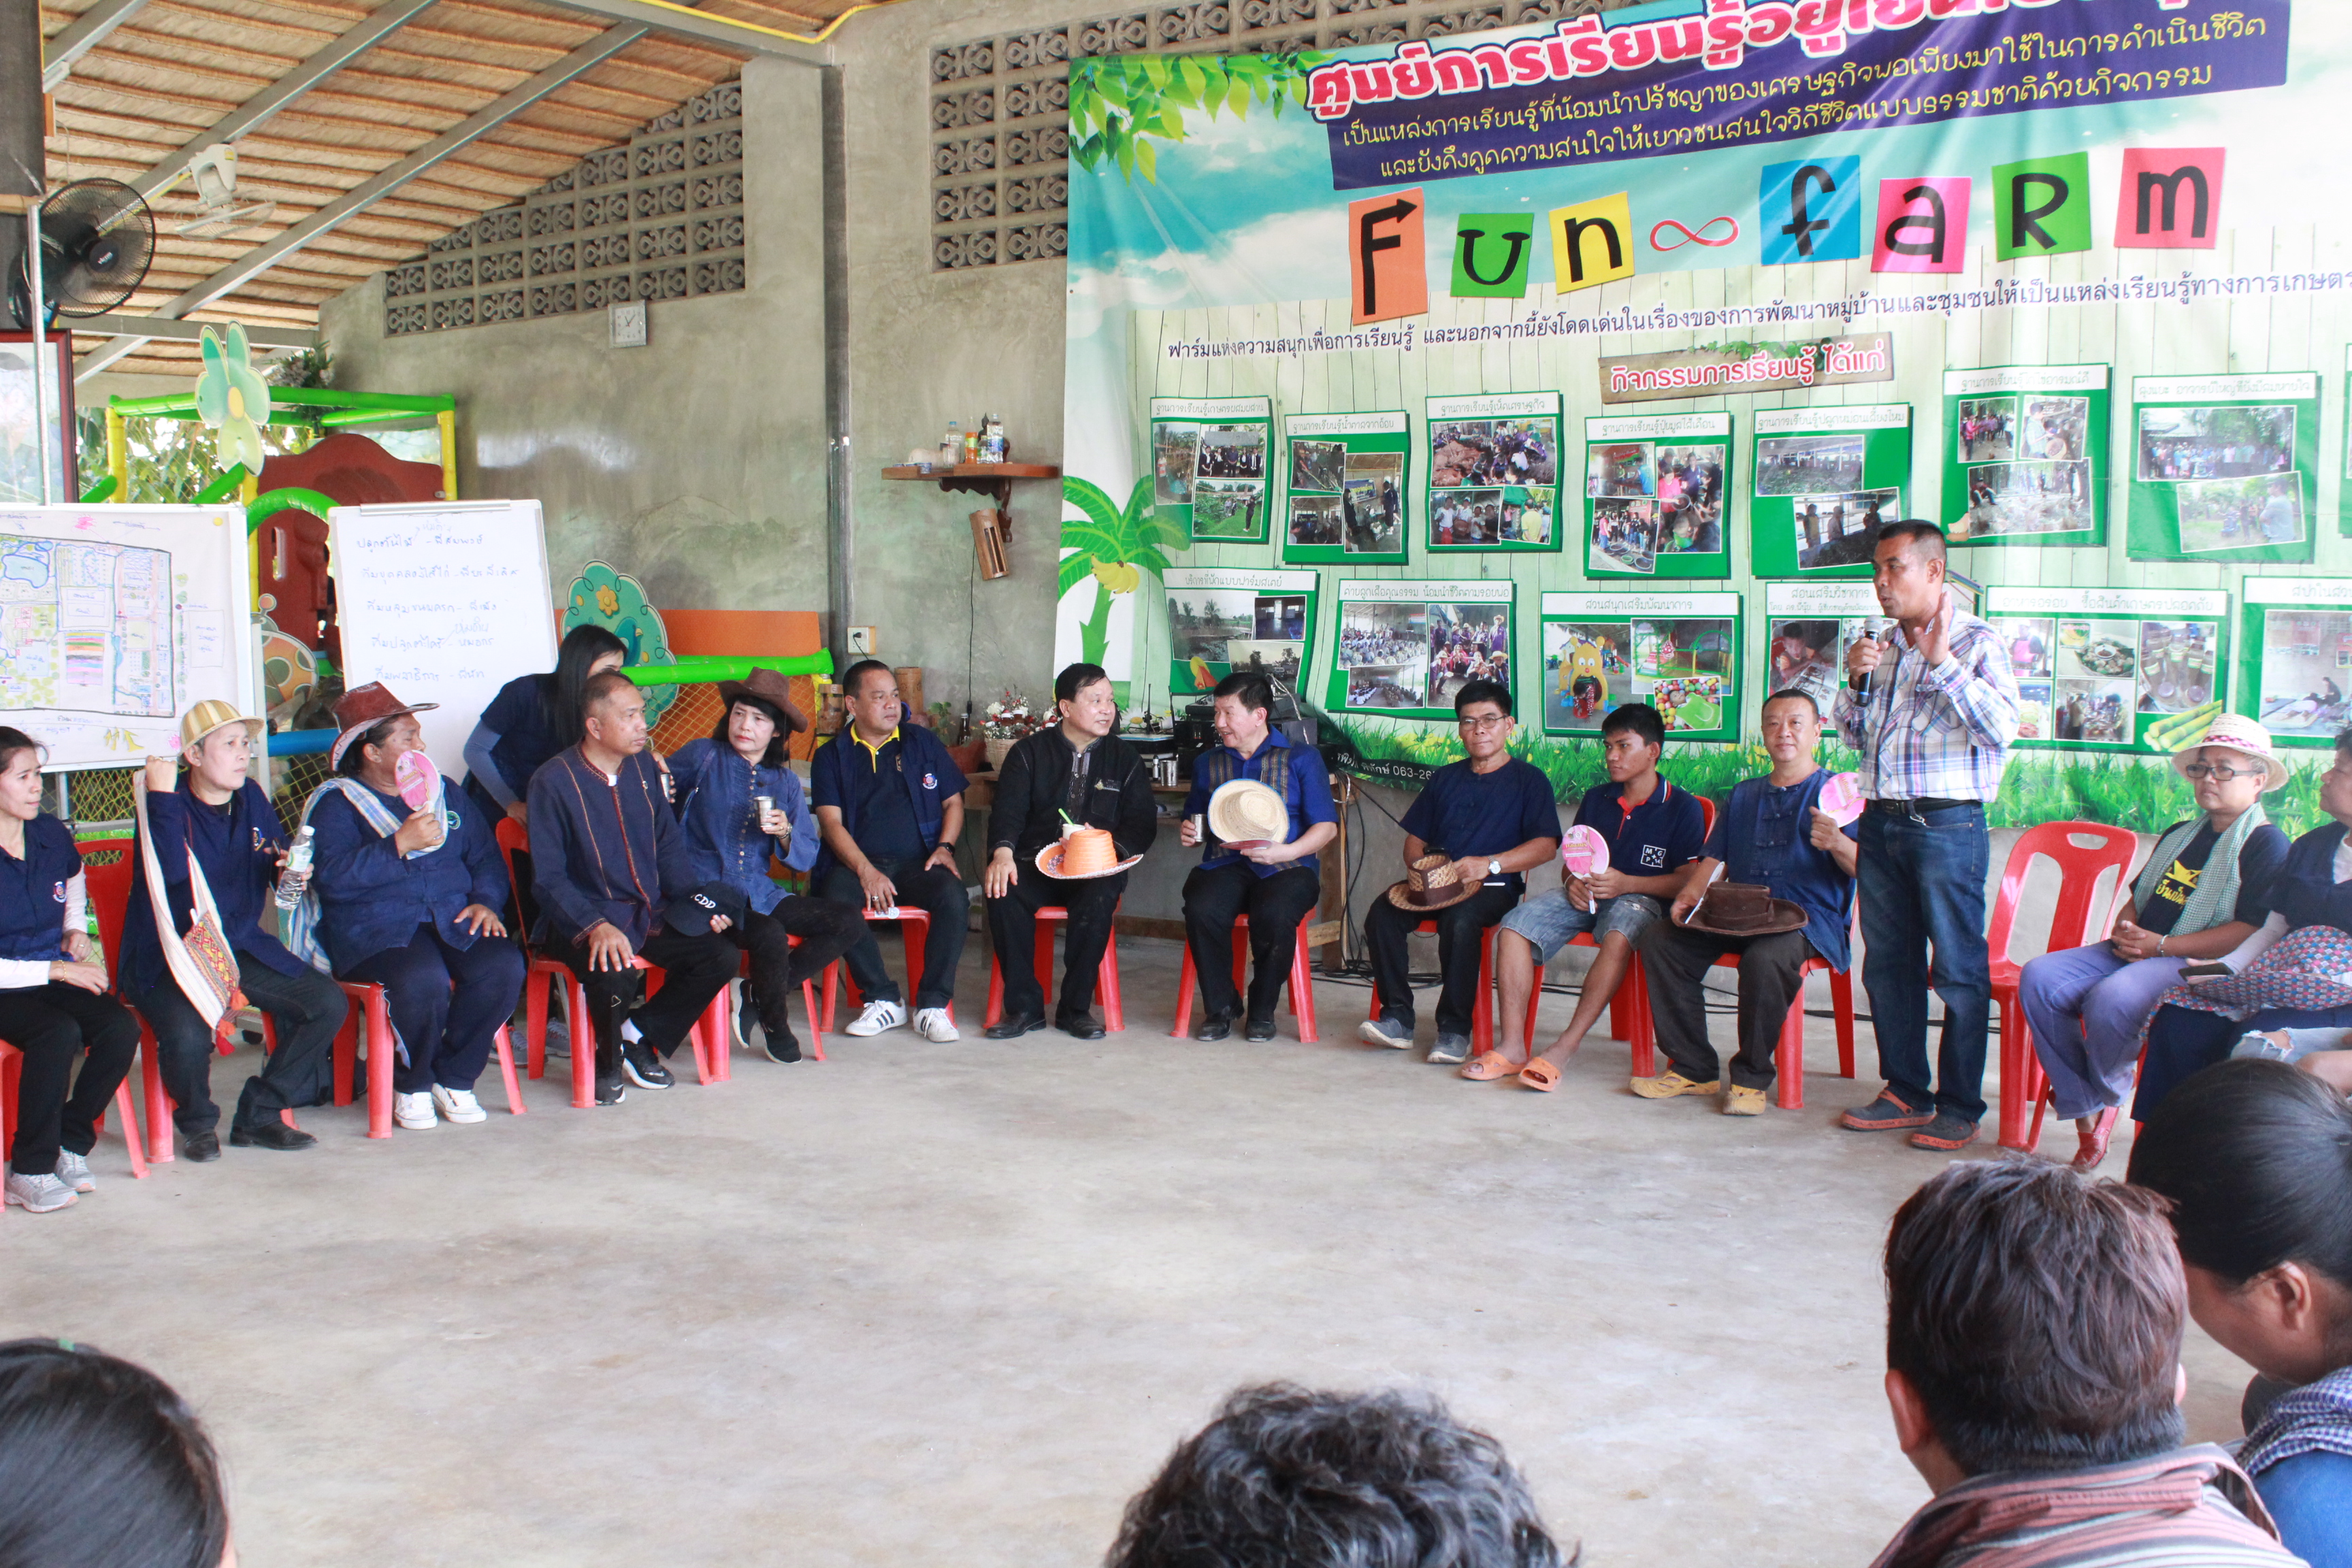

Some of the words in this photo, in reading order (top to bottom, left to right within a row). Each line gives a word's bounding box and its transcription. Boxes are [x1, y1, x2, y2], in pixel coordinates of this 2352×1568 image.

[1610, 346, 1816, 393] กิจกรรมการเรียนรู้
[1823, 340, 1886, 376] ได้แก่
[1343, 585, 1419, 600] ค่ายลูกเสือคุณธรรม
[1791, 585, 1870, 599] สอนเสริมวิชาการ
[1585, 596, 1693, 614] สวนสนุกเสริมพัฒนาการ
[1392, 766, 1435, 781] 063-26
[693, 894, 717, 909] CDD
